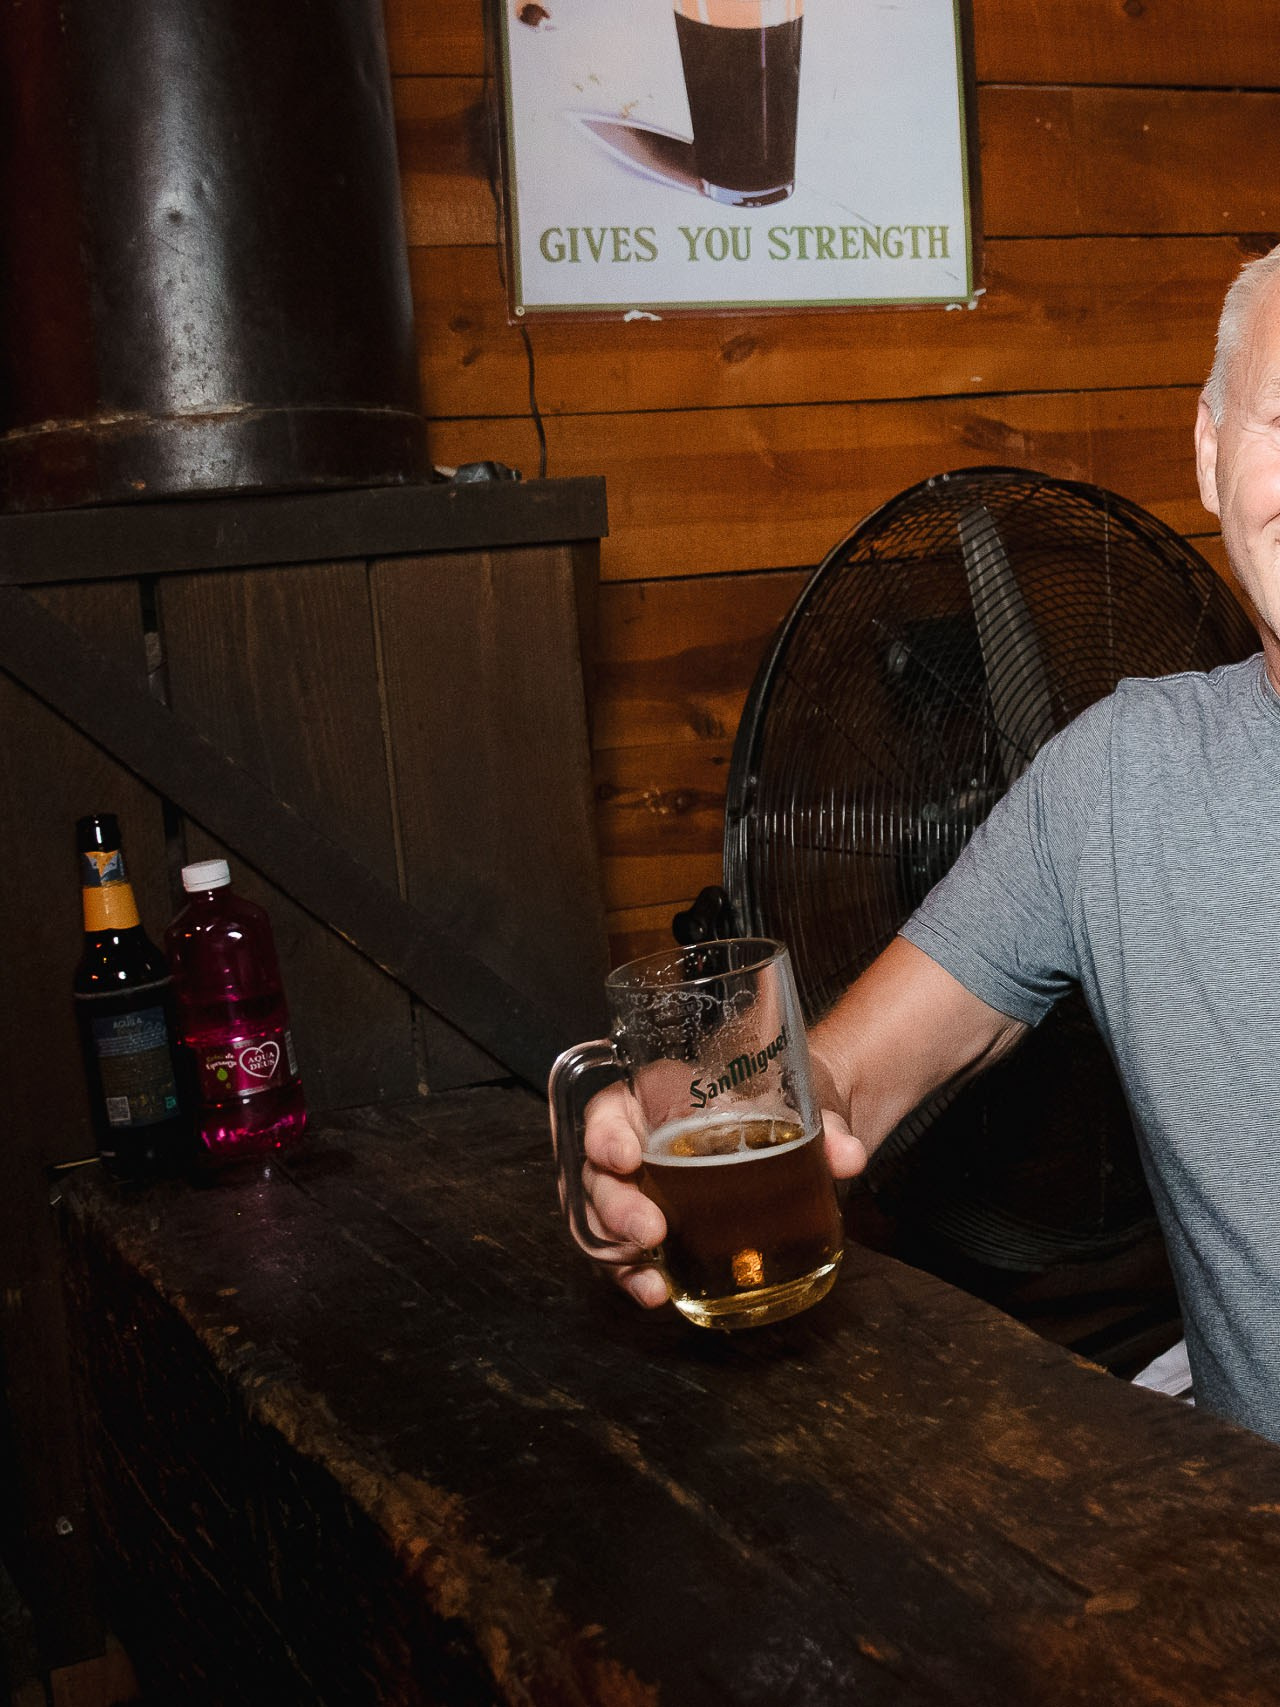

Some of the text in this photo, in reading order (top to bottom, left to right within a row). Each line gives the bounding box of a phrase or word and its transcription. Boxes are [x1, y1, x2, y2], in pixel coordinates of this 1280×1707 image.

[539, 225, 950, 264] GIVES YOU STRENGTH
[248, 1051, 275, 1065] AQUA
